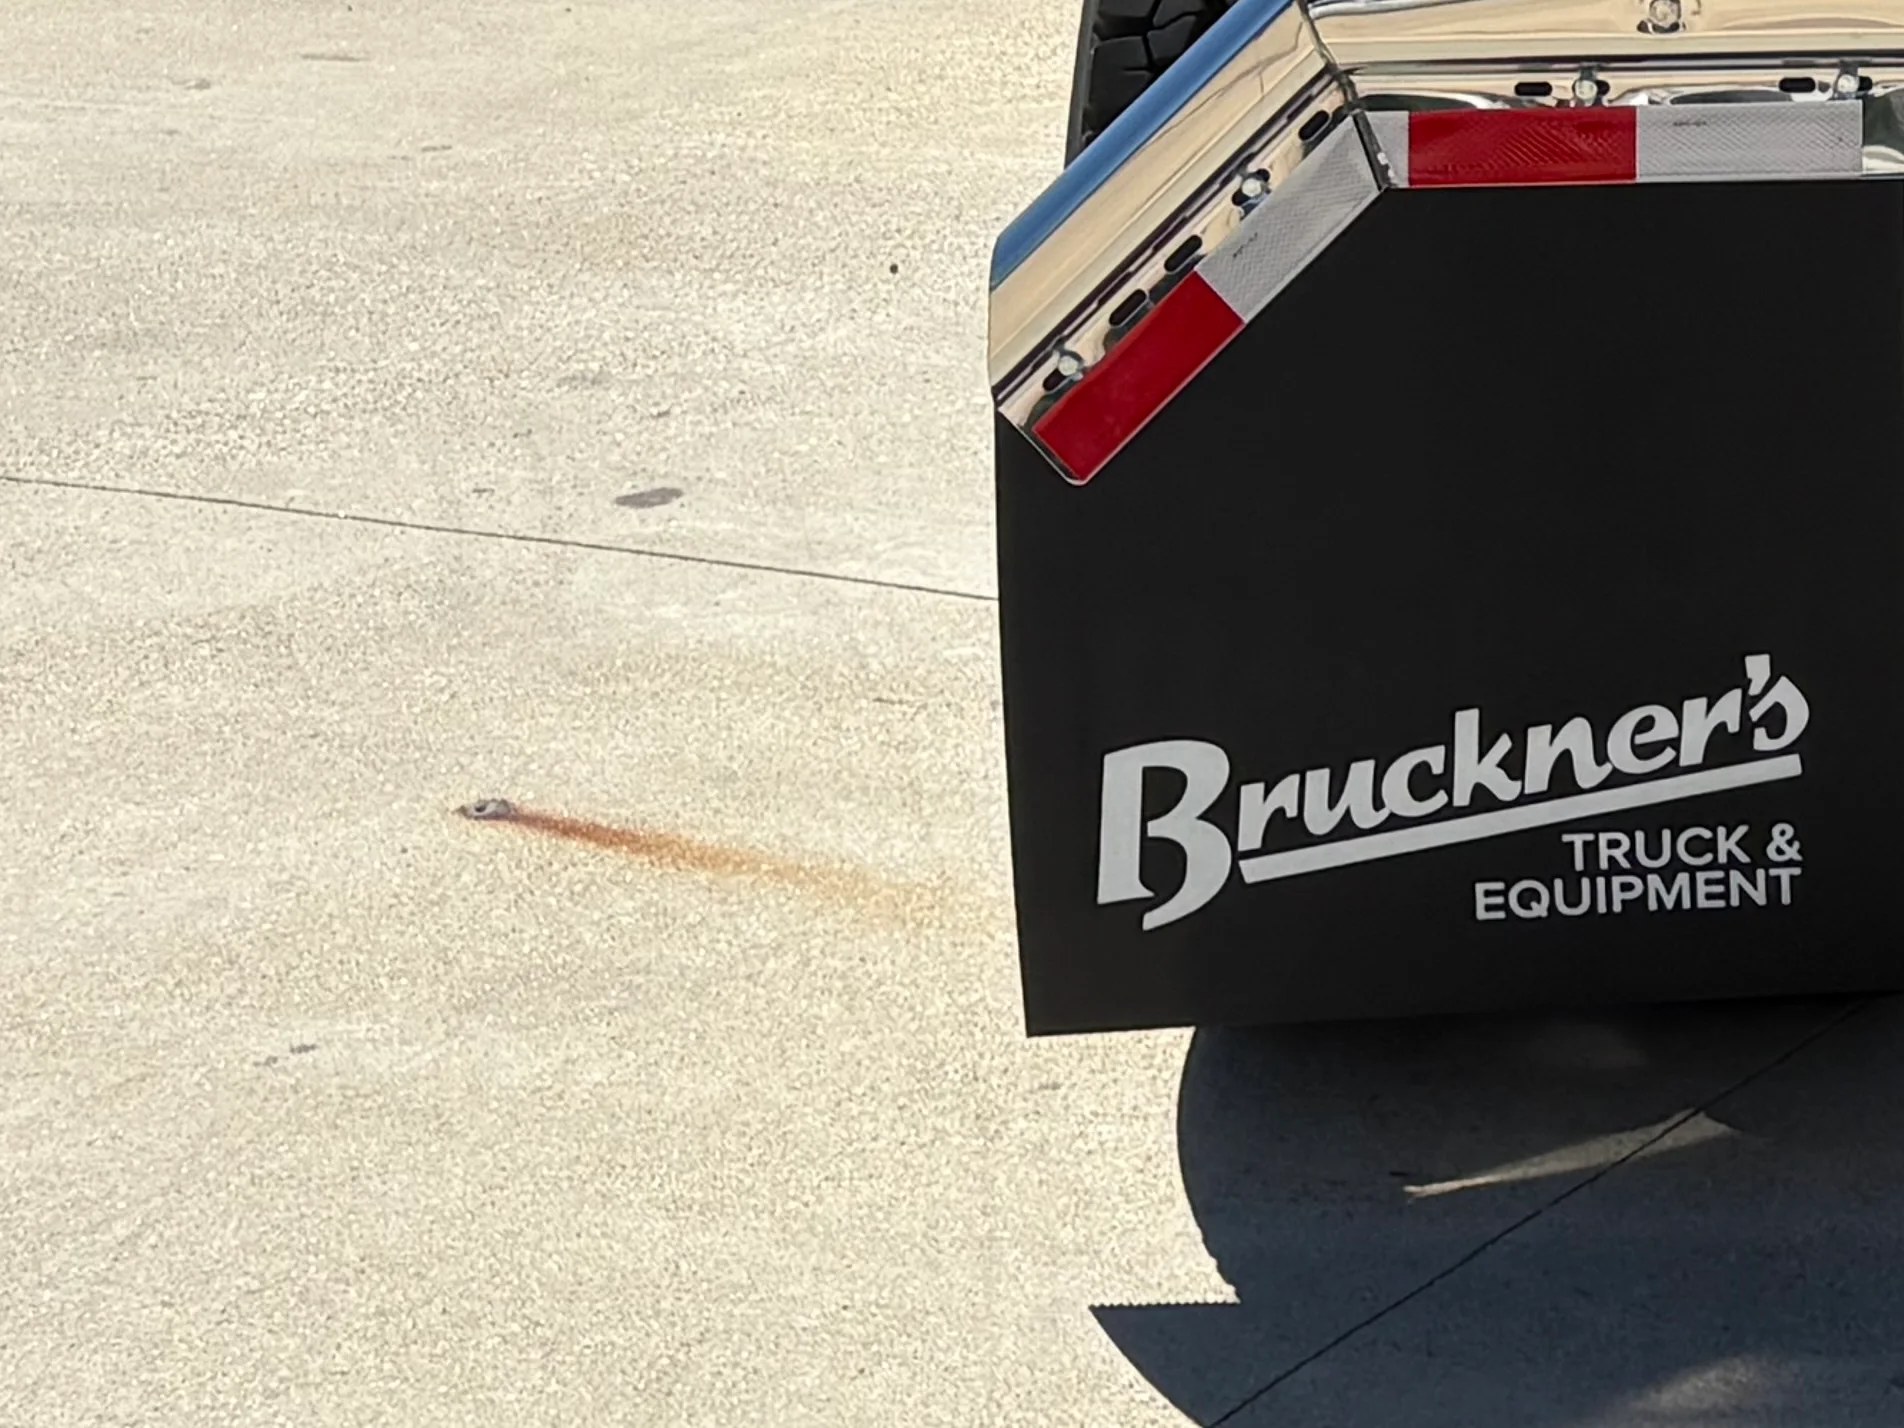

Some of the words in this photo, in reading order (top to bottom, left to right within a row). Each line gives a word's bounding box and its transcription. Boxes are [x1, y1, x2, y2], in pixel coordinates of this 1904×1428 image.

[1098, 654, 1810, 931] Bruckner's
[1561, 825, 1750, 873] TRUCK
[1766, 823, 1803, 862] &
[1474, 867, 1803, 922] EQUIPMENT
